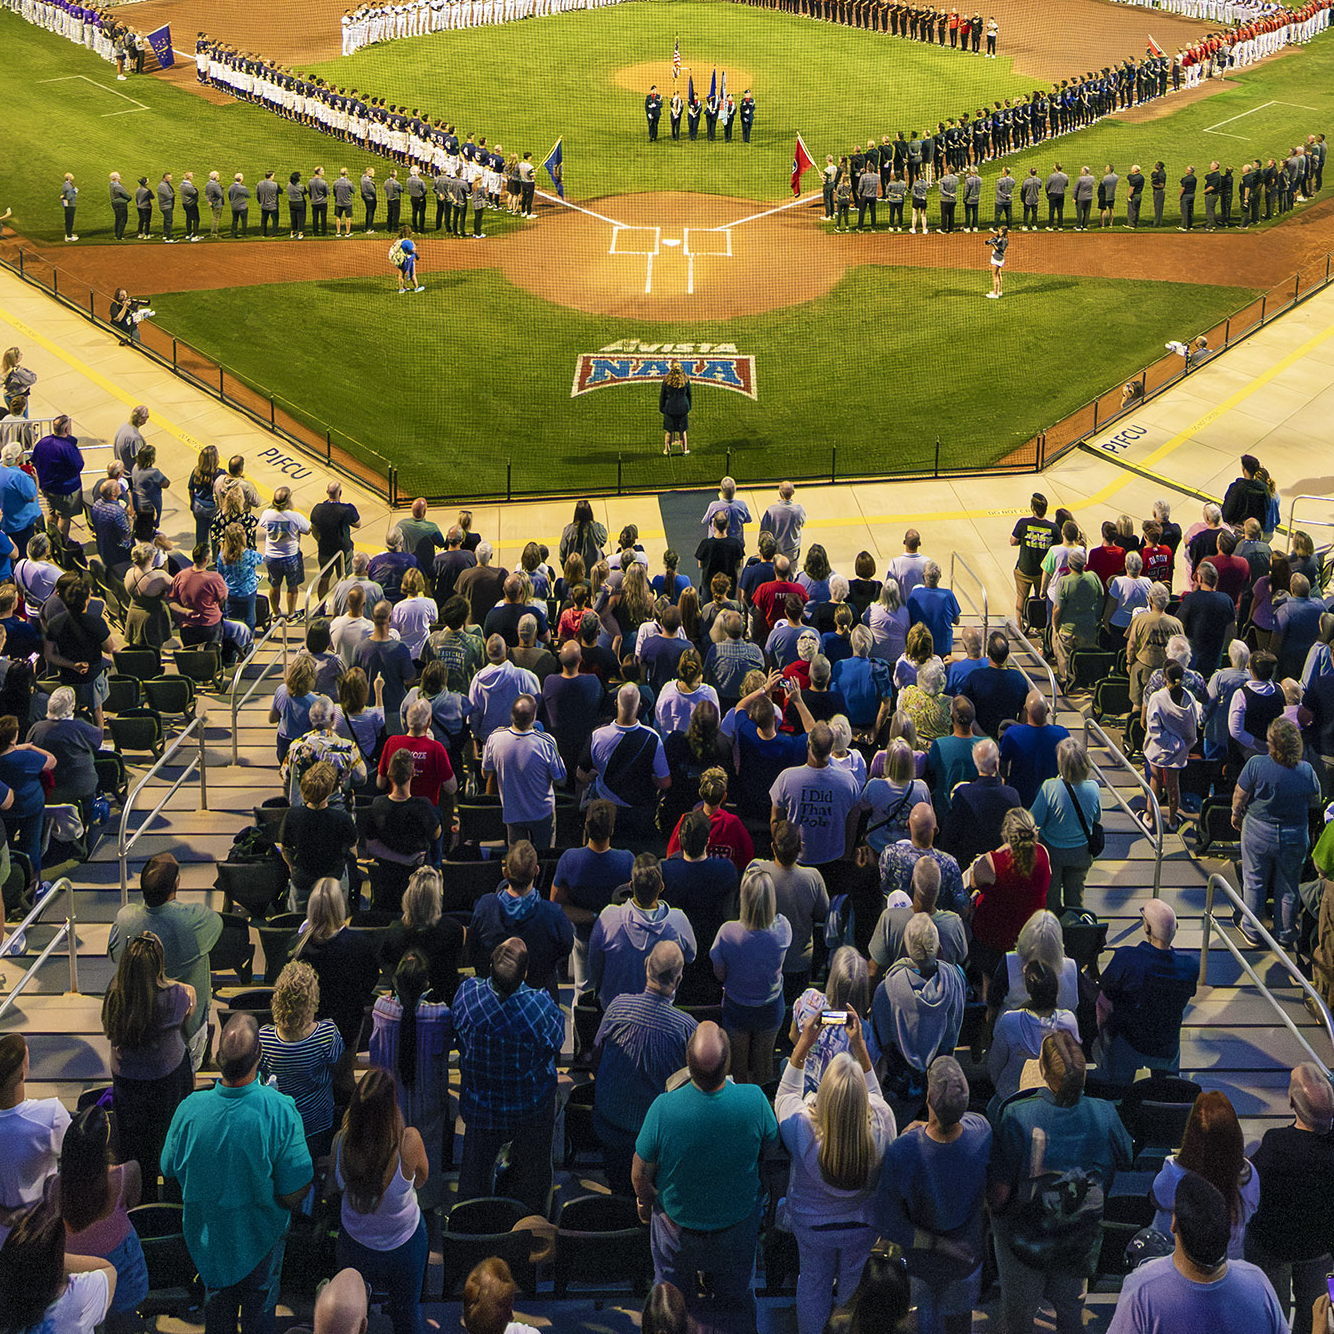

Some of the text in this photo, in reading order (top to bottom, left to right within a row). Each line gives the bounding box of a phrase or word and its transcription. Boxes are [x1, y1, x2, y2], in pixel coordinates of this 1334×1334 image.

[586, 359, 744, 387] NAIA
[802, 788, 833, 803] I Did
[800, 802, 832, 816] That
